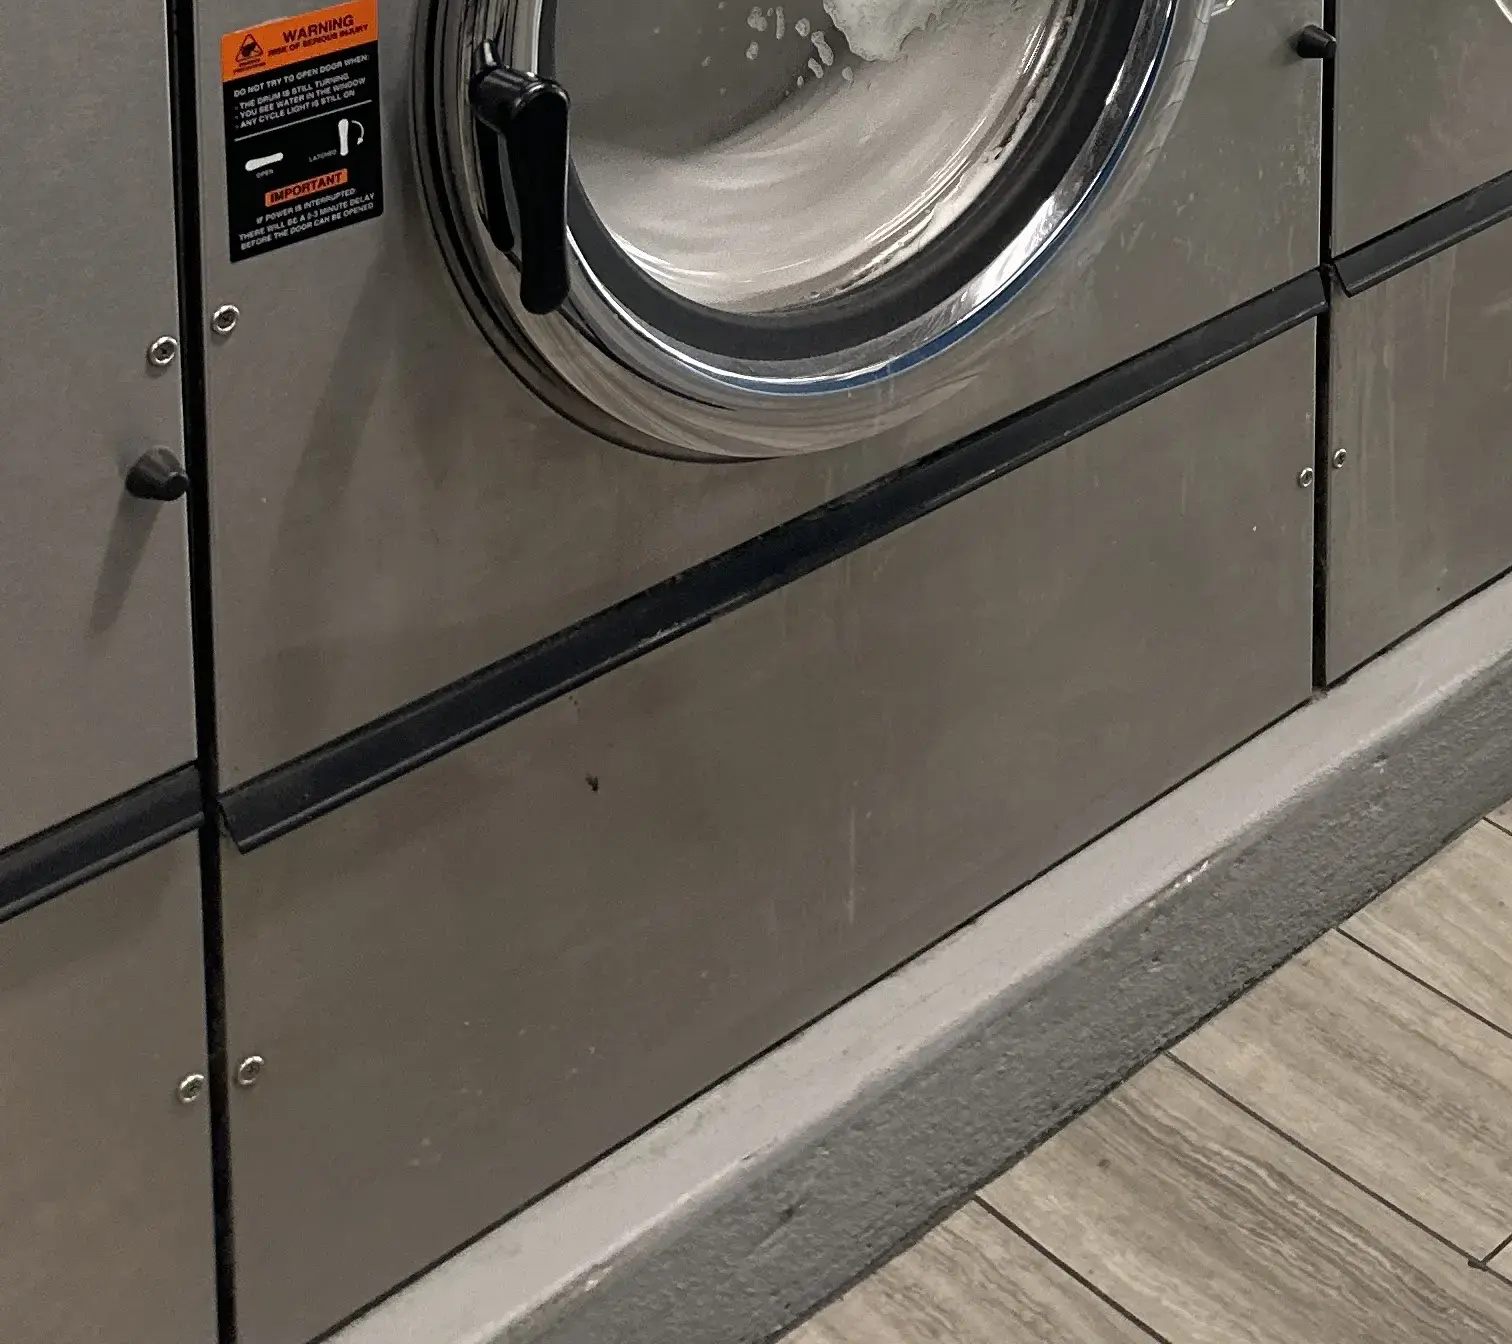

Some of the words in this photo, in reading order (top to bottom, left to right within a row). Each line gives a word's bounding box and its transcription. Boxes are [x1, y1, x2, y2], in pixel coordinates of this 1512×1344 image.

[268, 46, 288, 56] RISK
[289, 42, 300, 51] OF
[302, 32, 338, 47] SERIOUS
[340, 24, 368, 38] INJURY
[283, 14, 354, 43] WARNING
[234, 88, 246, 97] DO
[248, 82, 264, 93] NOT
[266, 78, 282, 88] TRY
[284, 74, 294, 84] TO
[296, 68, 318, 79] OPEN
[320, 61, 342, 73] DOOR
[240, 100, 255, 109] THE
[257, 92, 280, 105] DRUM
[282, 89, 290, 97] IS
[292, 84, 313, 94] STILL
[315, 73, 349, 88] TURNING
[240, 109, 257, 118] YOU
[259, 103, 274, 112] SEE
[276, 94, 304, 108] WATER
[316, 87, 331, 97] THE
[333, 77, 365, 92] WINDOW
[240, 118, 257, 128] ANY
[259, 110, 285, 123] CYCLE
[287, 103, 309, 115] LIGHT
[311, 100, 319, 108] IS
[321, 94, 341, 105] STILL
[343, 90, 355, 98] ON
[308, 149, 337, 162] LATCHED
[256, 169, 273, 178] OPEN
[270, 172, 342, 203] IMPORTANT
[239, 228, 265, 241] THERE
[267, 222, 285, 232] WILL
[288, 218, 298, 226] BE
[300, 214, 305, 222] A
[320, 202, 348, 216] MINUTE
[349, 193, 375, 206] DELAY
[241, 235, 272, 250] BEFORE
[274, 229, 288, 240] THE
[290, 222, 312, 234] DOOR
[314, 216, 330, 226] CAN
[332, 212, 342, 220] BE
[343, 202, 373, 216] OPENED
[256, 216, 263, 224] IF
[265, 207, 293, 222] POWER
[295, 204, 302, 212] IS
